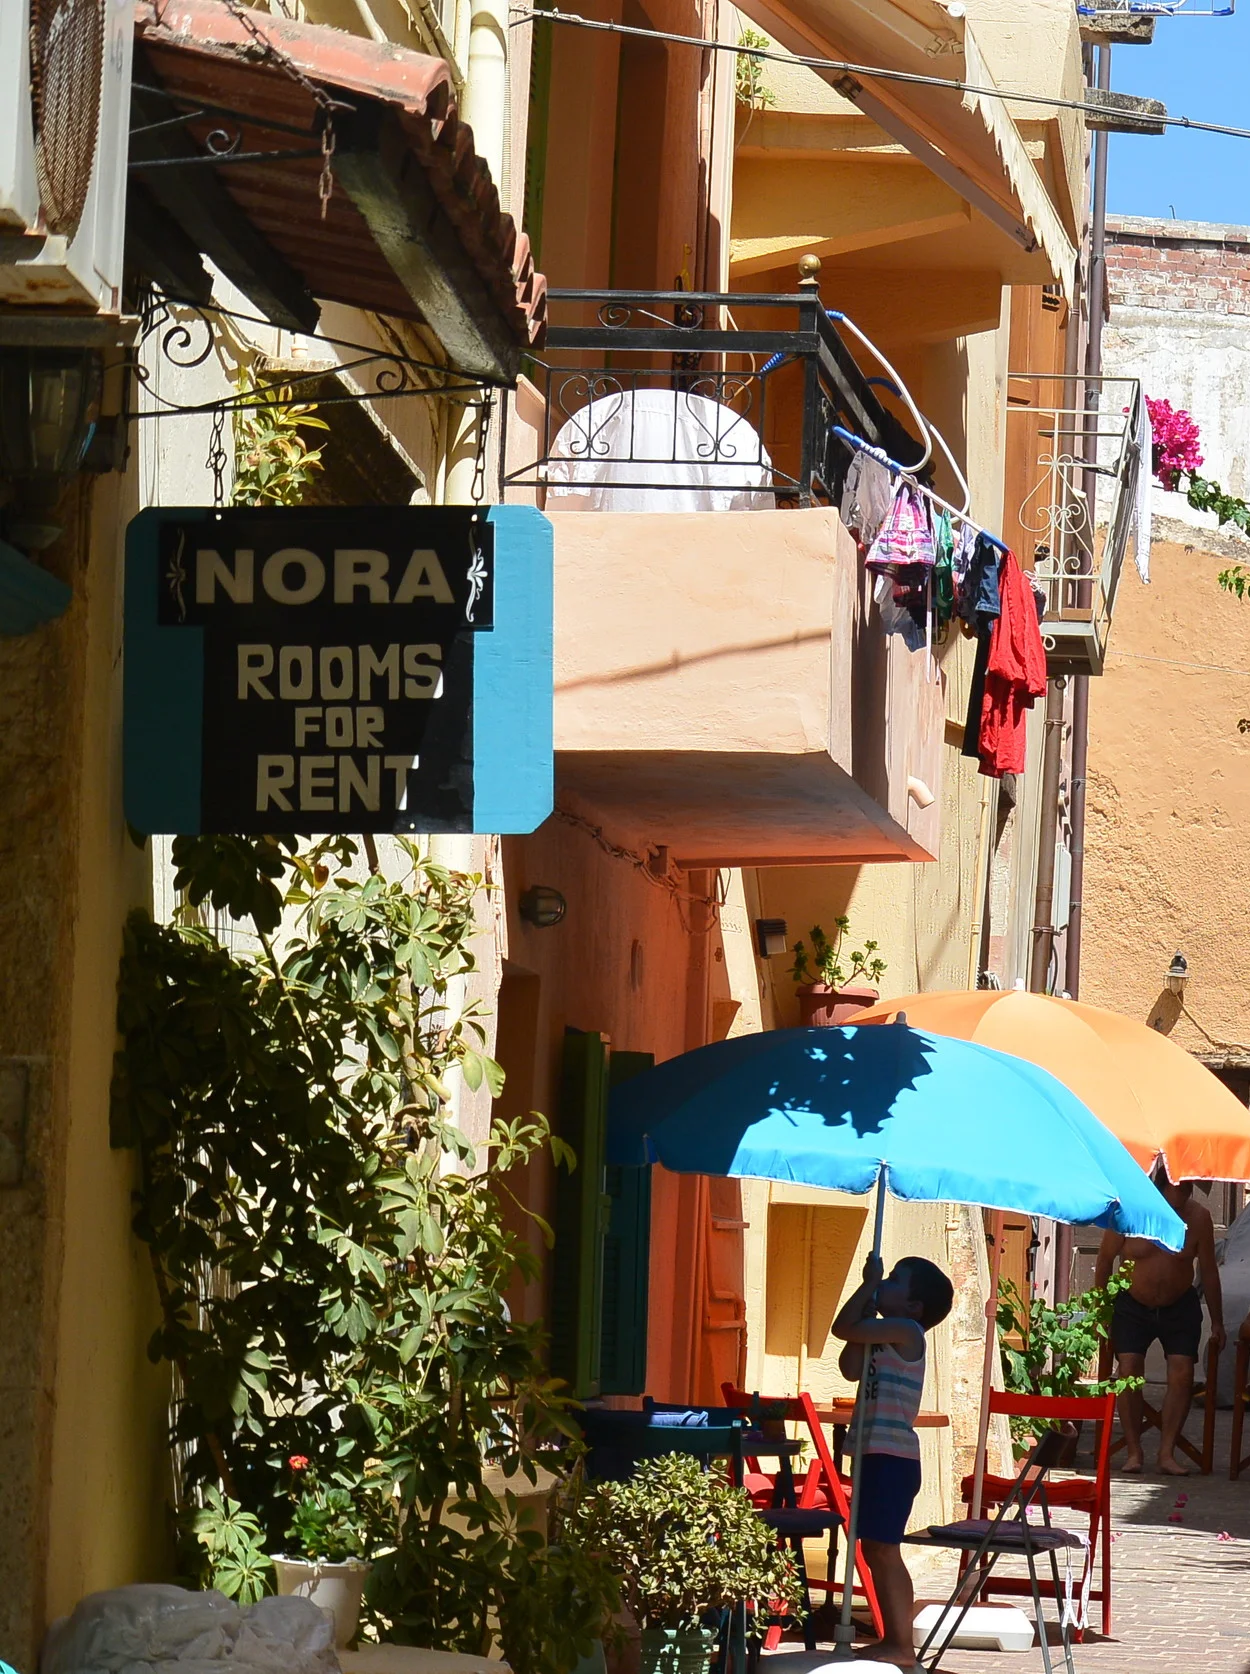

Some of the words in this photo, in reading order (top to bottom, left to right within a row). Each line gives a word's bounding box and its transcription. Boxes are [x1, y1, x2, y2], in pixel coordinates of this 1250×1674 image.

[196, 548, 455, 605] NORA
[237, 643, 444, 700] ROOMS
[294, 706, 385, 748] FOR
[255, 754, 420, 813] RENT
